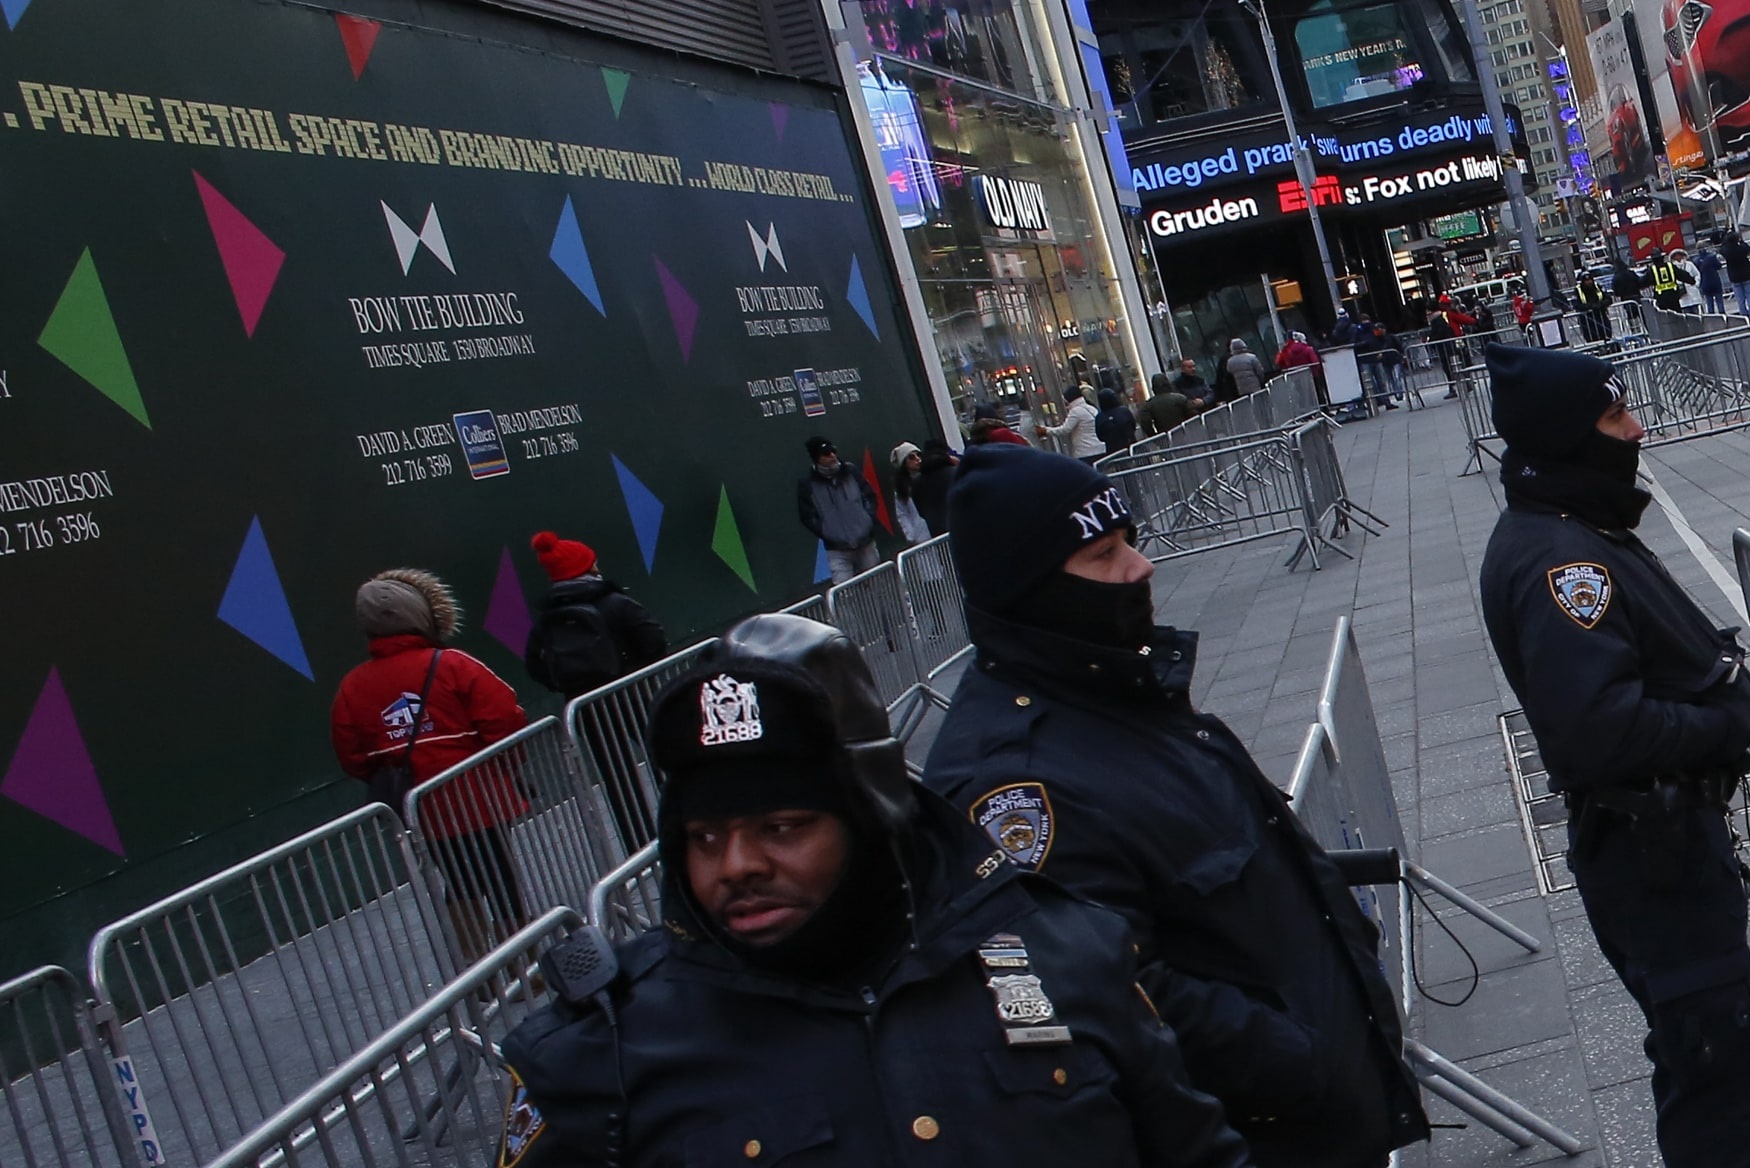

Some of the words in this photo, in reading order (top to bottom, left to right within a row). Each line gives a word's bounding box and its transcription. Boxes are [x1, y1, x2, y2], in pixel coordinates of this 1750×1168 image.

[1335, 48, 1359, 64] NEW
[160, 98, 292, 153] RETAIL
[289, 113, 388, 161] SPACE
[386, 124, 441, 166] AND
[439, 129, 558, 176] BRANDING
[557, 143, 684, 187] OPPORTUNITY
[754, 167, 796, 198] CLASS
[1131, 148, 1240, 194] Alleged
[1339, 138, 1395, 163] urns
[1398, 115, 1476, 152] deadly
[1474, 112, 1494, 135] wit
[982, 174, 1016, 229] OLD
[1008, 179, 1050, 231] NAVY
[1150, 196, 1259, 238] Gruden
[1364, 173, 1414, 203] Fox
[1416, 161, 1461, 192] not
[1461, 153, 1498, 182] likely
[348, 296, 402, 334] BOW
[401, 294, 439, 331] TIE
[434, 292, 525, 330] BUILDING
[736, 287, 764, 313] BOW
[760, 286, 781, 312] TIE
[777, 286, 824, 311] BUILDING
[362, 346, 403, 369] TIMES
[400, 341, 450, 369] SQUARE
[452, 338, 477, 362] 1530
[475, 334, 536, 360] BROADWAY
[461, 424, 497, 446] Colliers
[497, 412, 527, 436] BRAD
[525, 404, 583, 431] MENDELSON
[357, 431, 401, 458] DAVID
[402, 429, 417, 452] A.
[413, 423, 456, 449] GREEN
[522, 438, 542, 460] 212
[539, 434, 557, 457] 716
[556, 431, 580, 453] 3596
[381, 460, 406, 486] 212
[404, 456, 427, 482] 716
[426, 453, 453, 479] 3599
[17, 520, 54, 551] 716
[56, 511, 101, 544] 3596
[1556, 572, 1605, 587] DEPARTMENT
[1565, 566, 1594, 576] POLICE
[1558, 592, 1572, 609] CITY
[1570, 608, 1581, 618] OF
[1590, 605, 1603, 620] NEW
[1599, 585, 1609, 606] YORK
[702, 723, 763, 746] 21688
[979, 798, 1042, 826] DEPARTMENT
[987, 788, 1026, 808] POLICE
[1030, 842, 1046, 864] NEW
[1039, 813, 1049, 841] YORK
[976, 849, 1007, 879] SSD
[114, 1060, 160, 1162] NYPD
